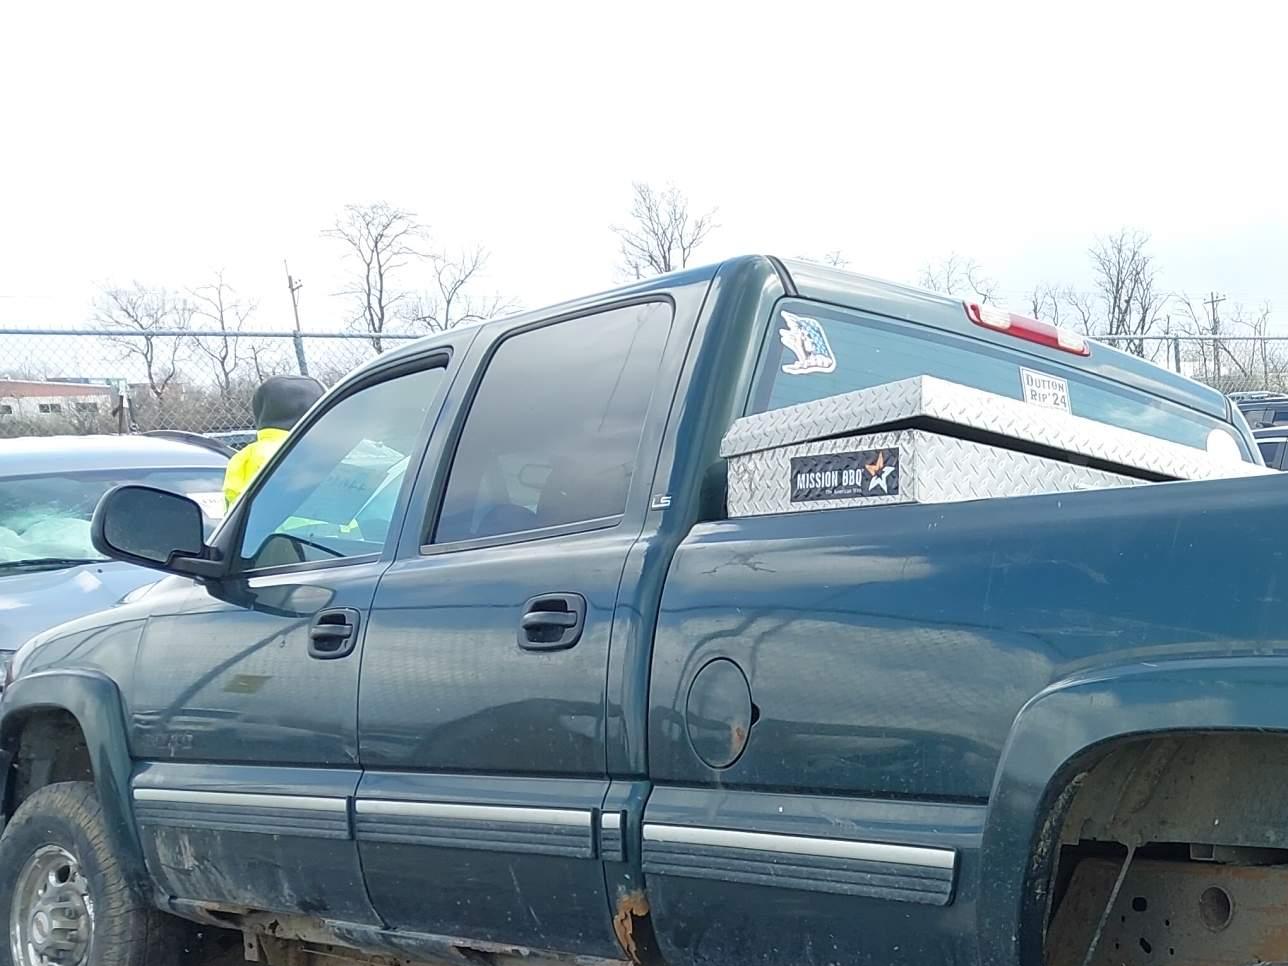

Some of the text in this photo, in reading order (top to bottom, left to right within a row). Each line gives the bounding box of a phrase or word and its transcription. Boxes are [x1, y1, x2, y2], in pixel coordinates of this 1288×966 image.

[1026, 373, 1065, 392] DUTTON
[797, 468, 863, 490] MISSION BBQ
[651, 495, 672, 509] LS
